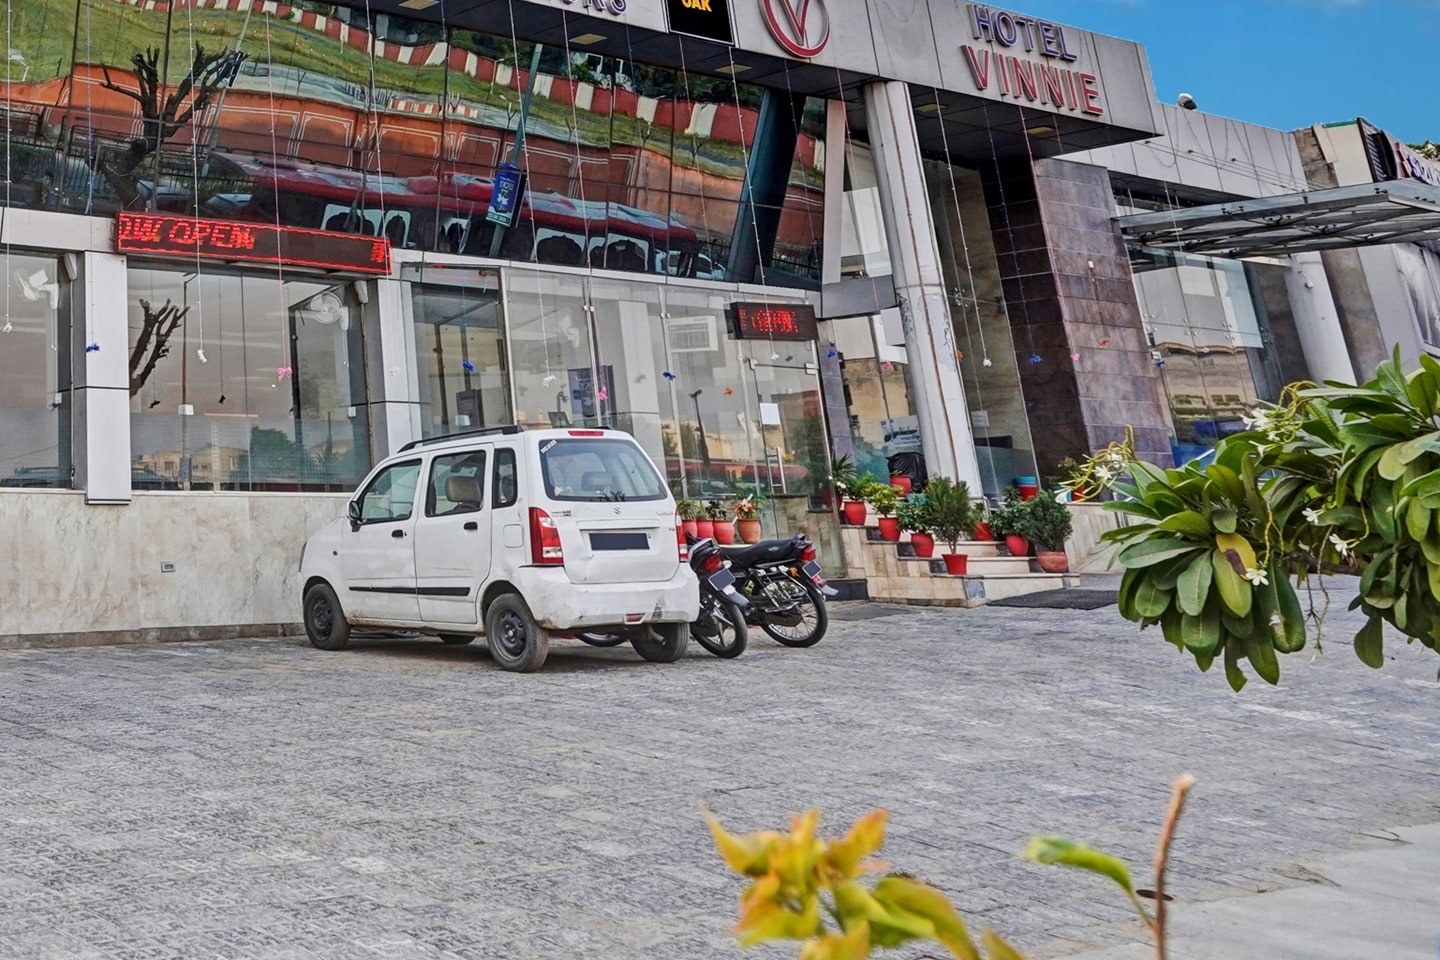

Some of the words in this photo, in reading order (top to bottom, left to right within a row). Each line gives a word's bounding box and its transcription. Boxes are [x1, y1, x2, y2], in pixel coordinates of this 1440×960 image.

[967, 3, 1078, 61] HOTEL
[960, 44, 1104, 116] VINNIE
[168, 222, 255, 250] OPEN
